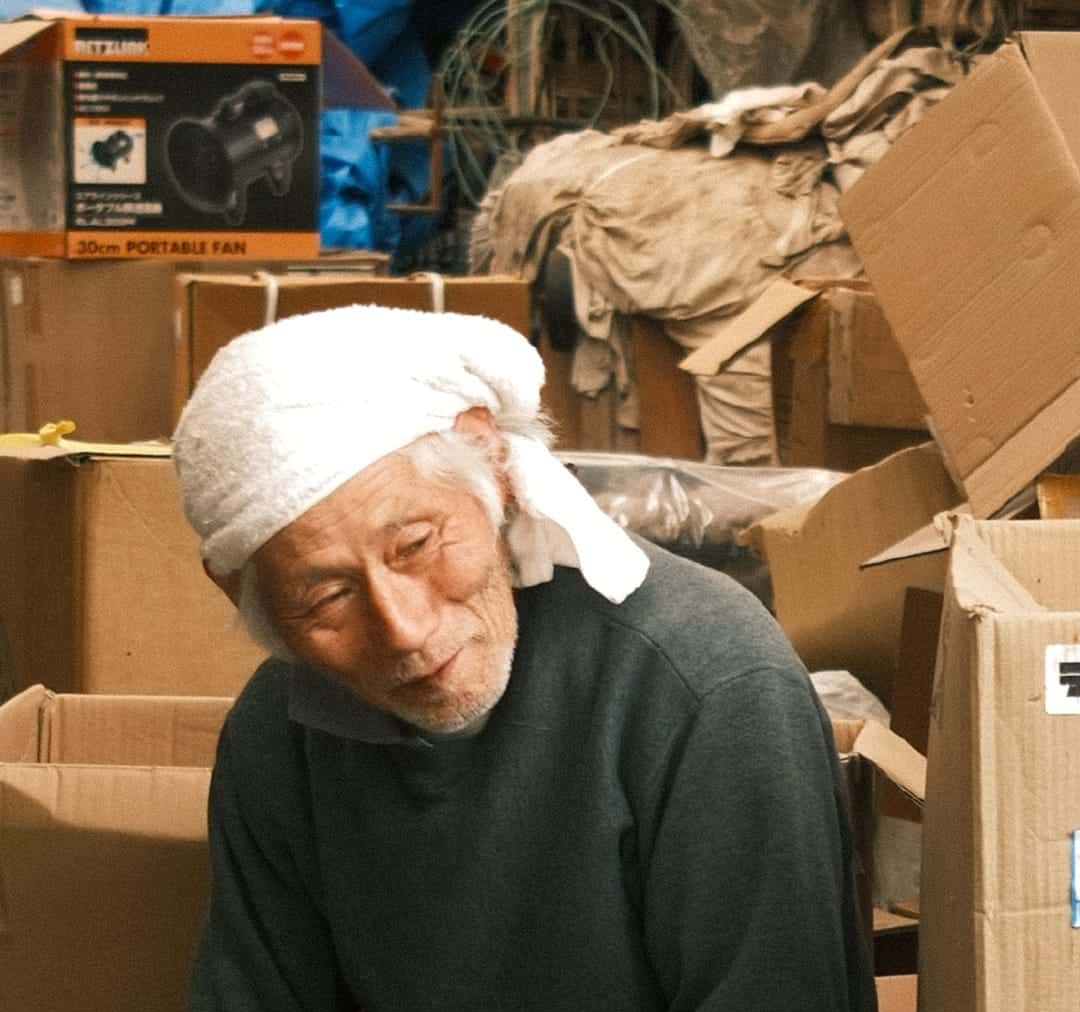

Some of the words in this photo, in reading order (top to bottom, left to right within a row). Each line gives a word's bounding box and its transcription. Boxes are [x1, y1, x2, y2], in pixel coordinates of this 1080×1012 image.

[78, 241, 121, 254] 30cm
[127, 241, 207, 254] PORTABLE
[212, 240, 247, 254] FAN
